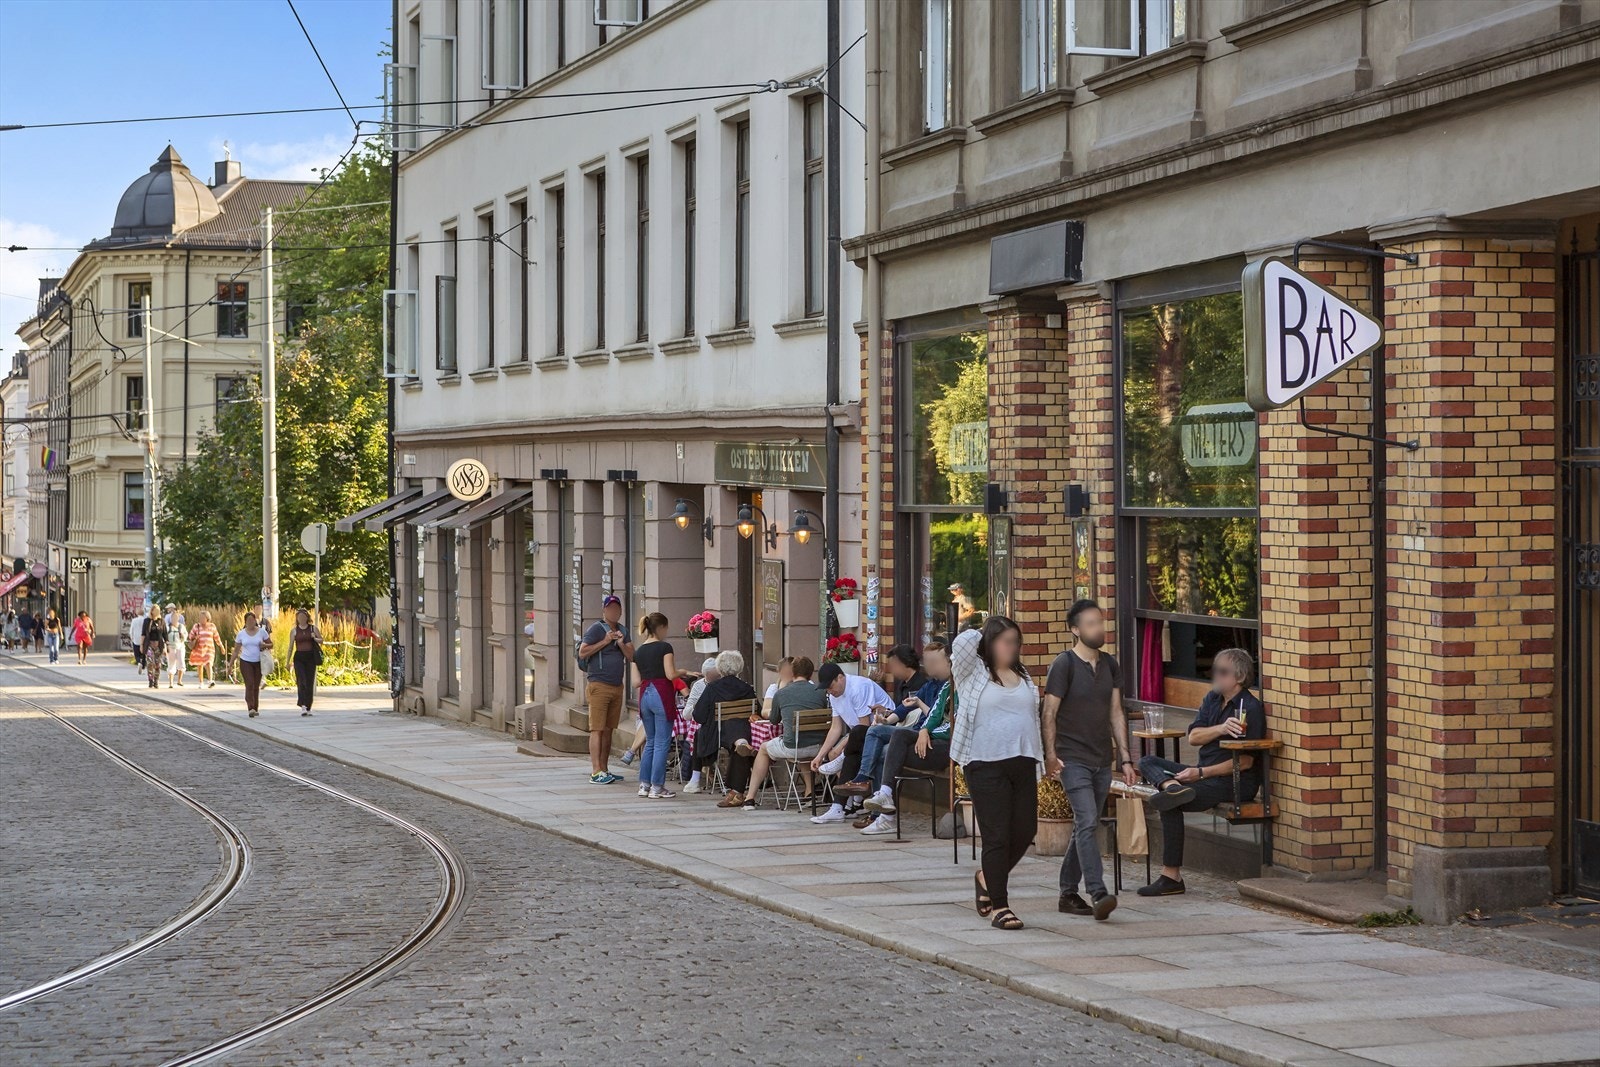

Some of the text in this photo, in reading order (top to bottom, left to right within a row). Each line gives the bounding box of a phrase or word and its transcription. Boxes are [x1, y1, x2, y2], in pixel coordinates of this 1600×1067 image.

[1279, 277, 1356, 388] BAR
[730, 448, 809, 472] OSTEBUTIKKEN
[72, 558, 87, 568] DLX
